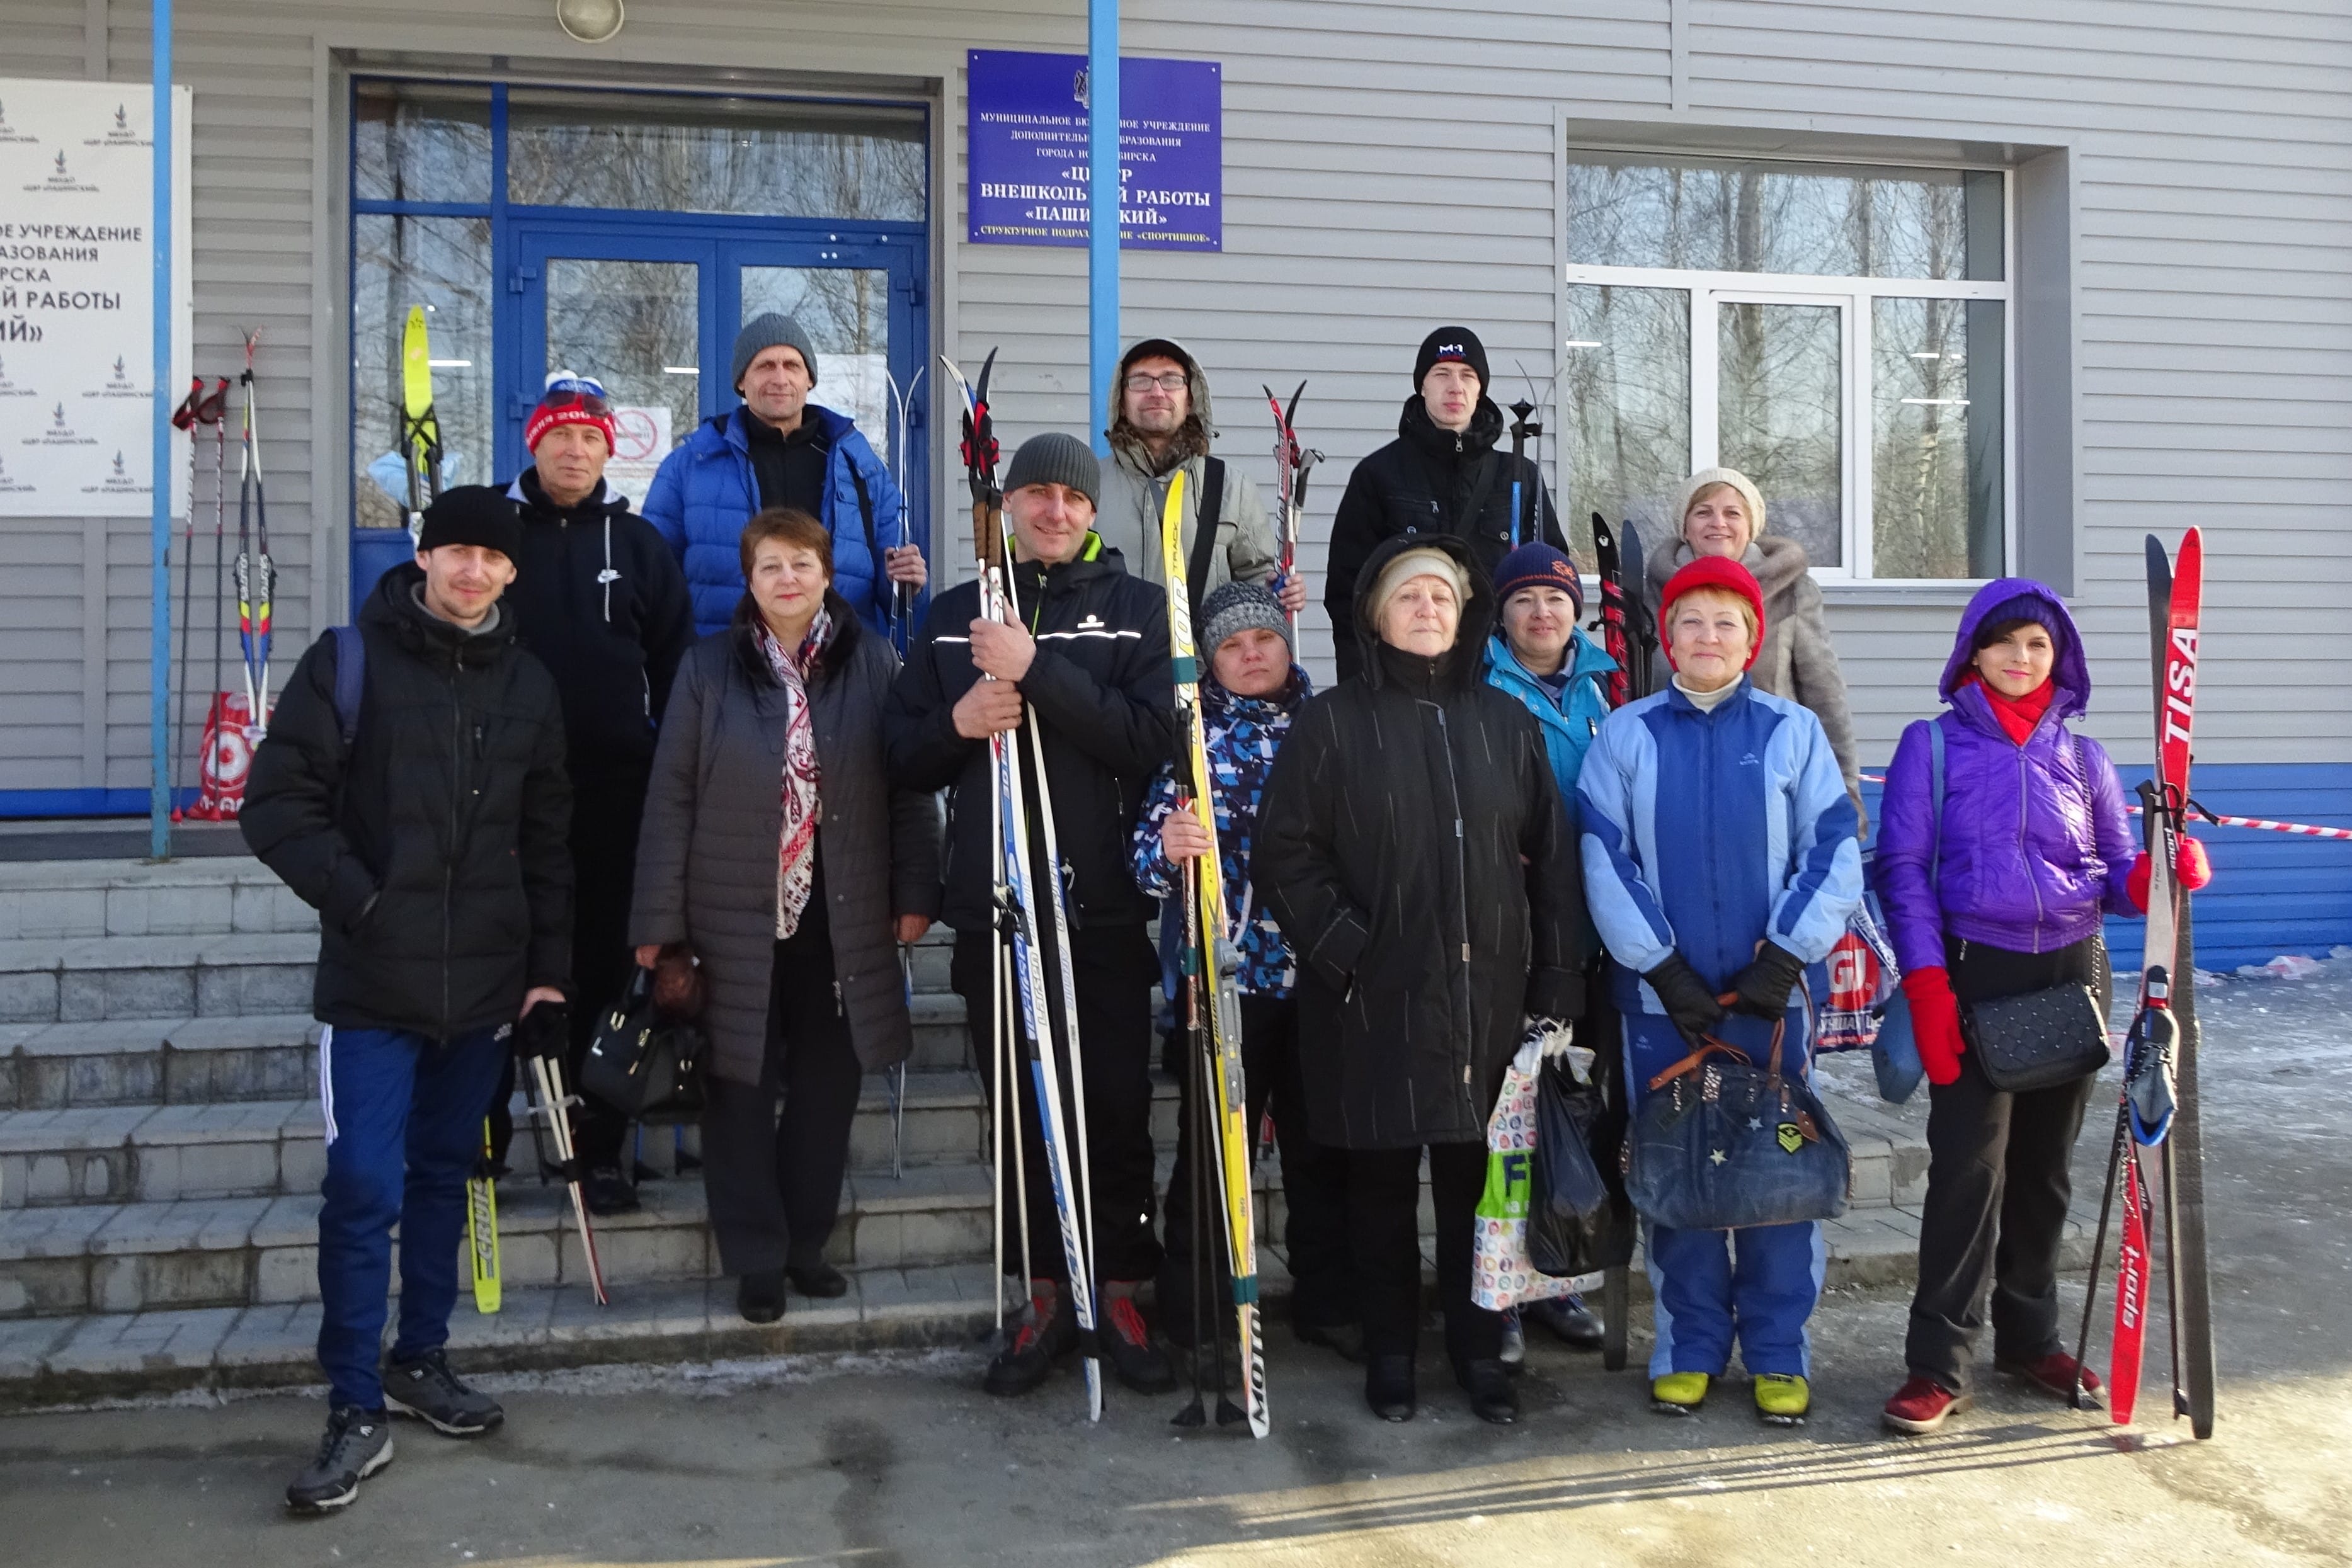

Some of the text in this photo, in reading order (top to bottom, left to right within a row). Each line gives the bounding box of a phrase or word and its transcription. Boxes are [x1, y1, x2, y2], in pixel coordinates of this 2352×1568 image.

[980, 112, 1071, 126] МУНИЦИПАЛЬНОЕ
[1143, 120, 1210, 132] УЧРЕЖДЕНИЕ
[1119, 135, 1181, 147] БРАЗОВАНИЯ
[1036, 147, 1074, 158] ГОРОДА
[981, 183, 1211, 207] ВНЕШКОЛЬЙ РАБОТЫ
[1025, 206, 1167, 225] «ПАШИКИЙ»
[20, 224, 142, 242] УЧРЕЖДЕНИЕ
[980, 225, 1048, 237] СТРУКТУРНОЕ
[26, 292, 120, 309] РАБОТЫ
[1439, 344, 1463, 354] M-1
[2164, 628, 2196, 744] TISA
[1056, 1203, 1090, 1330] ARCTIC
